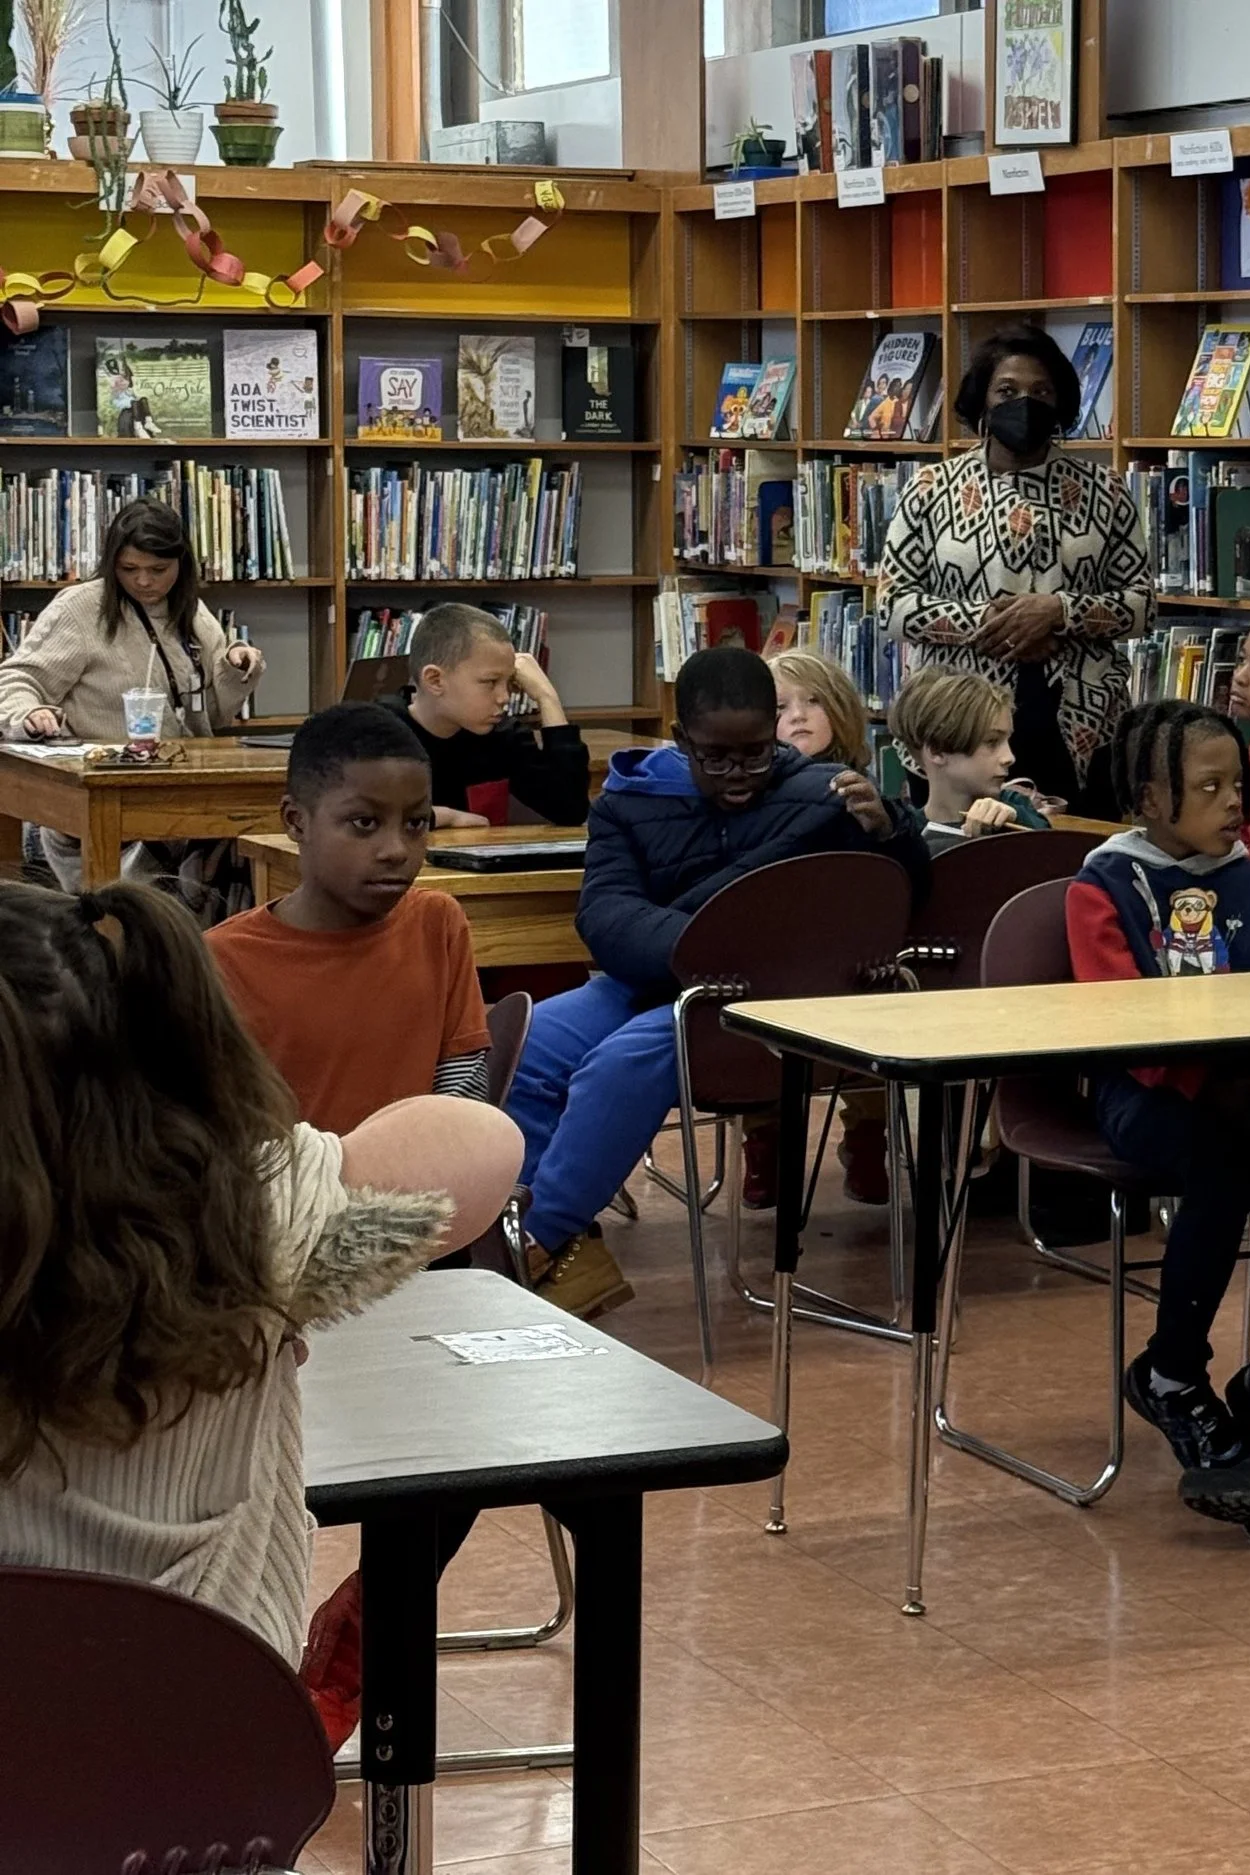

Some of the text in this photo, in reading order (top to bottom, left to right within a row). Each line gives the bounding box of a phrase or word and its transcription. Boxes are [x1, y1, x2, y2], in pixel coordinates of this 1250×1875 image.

[1080, 327, 1113, 346] BLUE
[882, 337, 922, 351] HIDDEN
[878, 351, 920, 366] FIGURES
[230, 383, 262, 396] ADA
[387, 376, 418, 399] SAY
[589, 399, 609, 410] THE
[230, 414, 308, 428] SCIENTIST
[584, 411, 613, 421] DARK
